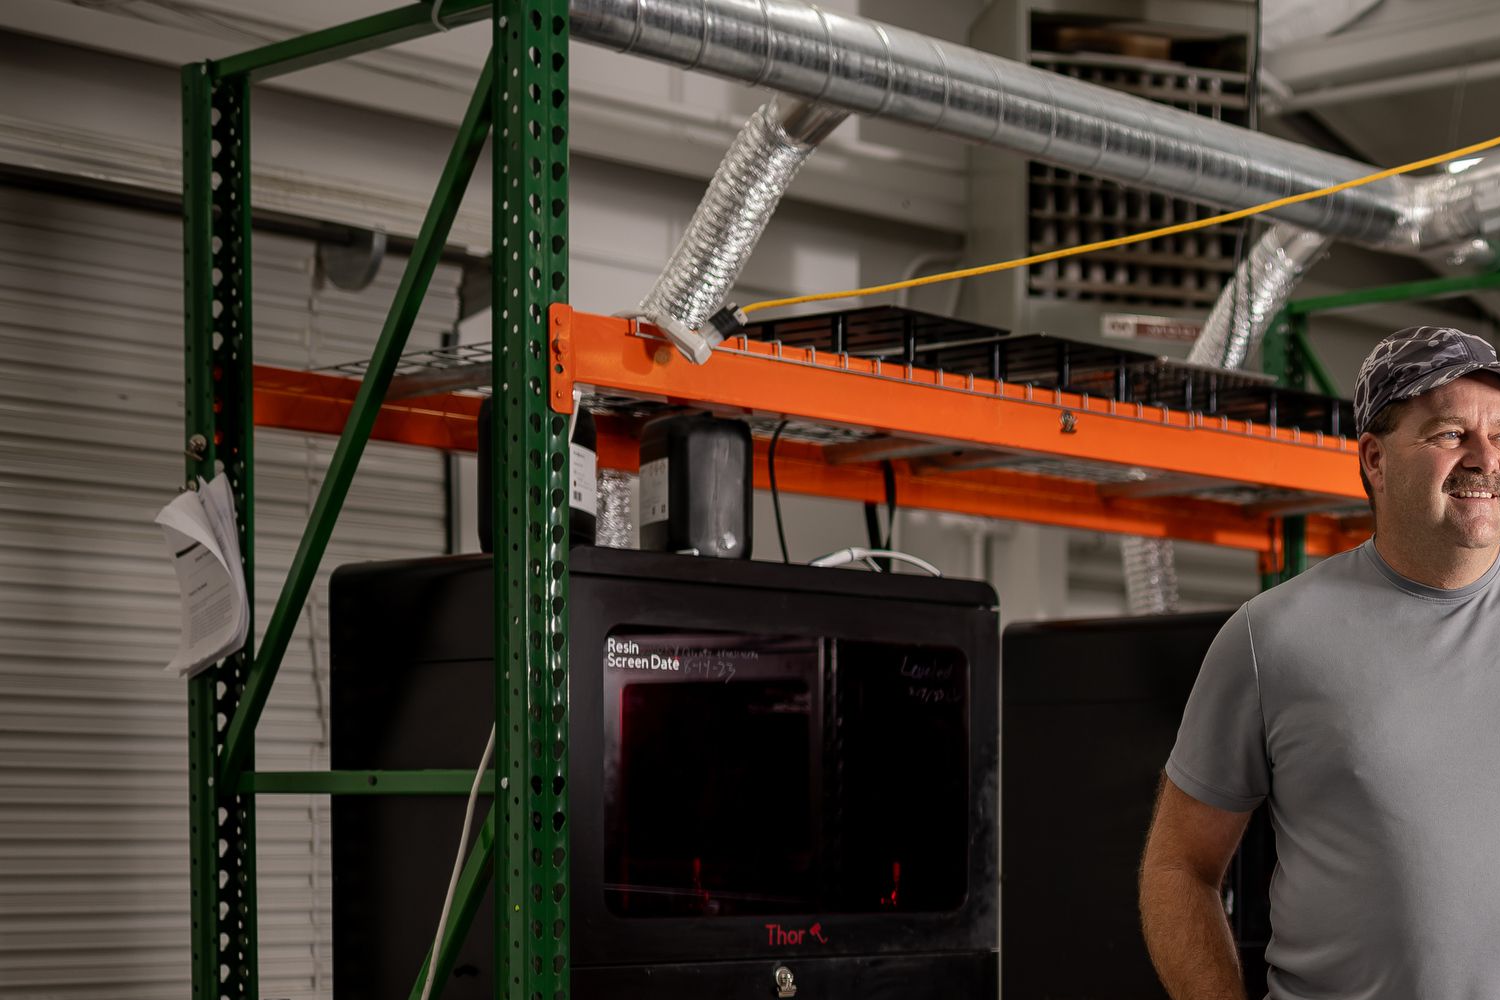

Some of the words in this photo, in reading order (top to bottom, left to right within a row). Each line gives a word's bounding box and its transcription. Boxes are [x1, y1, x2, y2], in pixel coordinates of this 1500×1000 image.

[607, 637, 639, 654] Resin
[607, 654, 648, 670] Screen
[651, 655, 680, 671] Date
[765, 923, 806, 947] Thor
